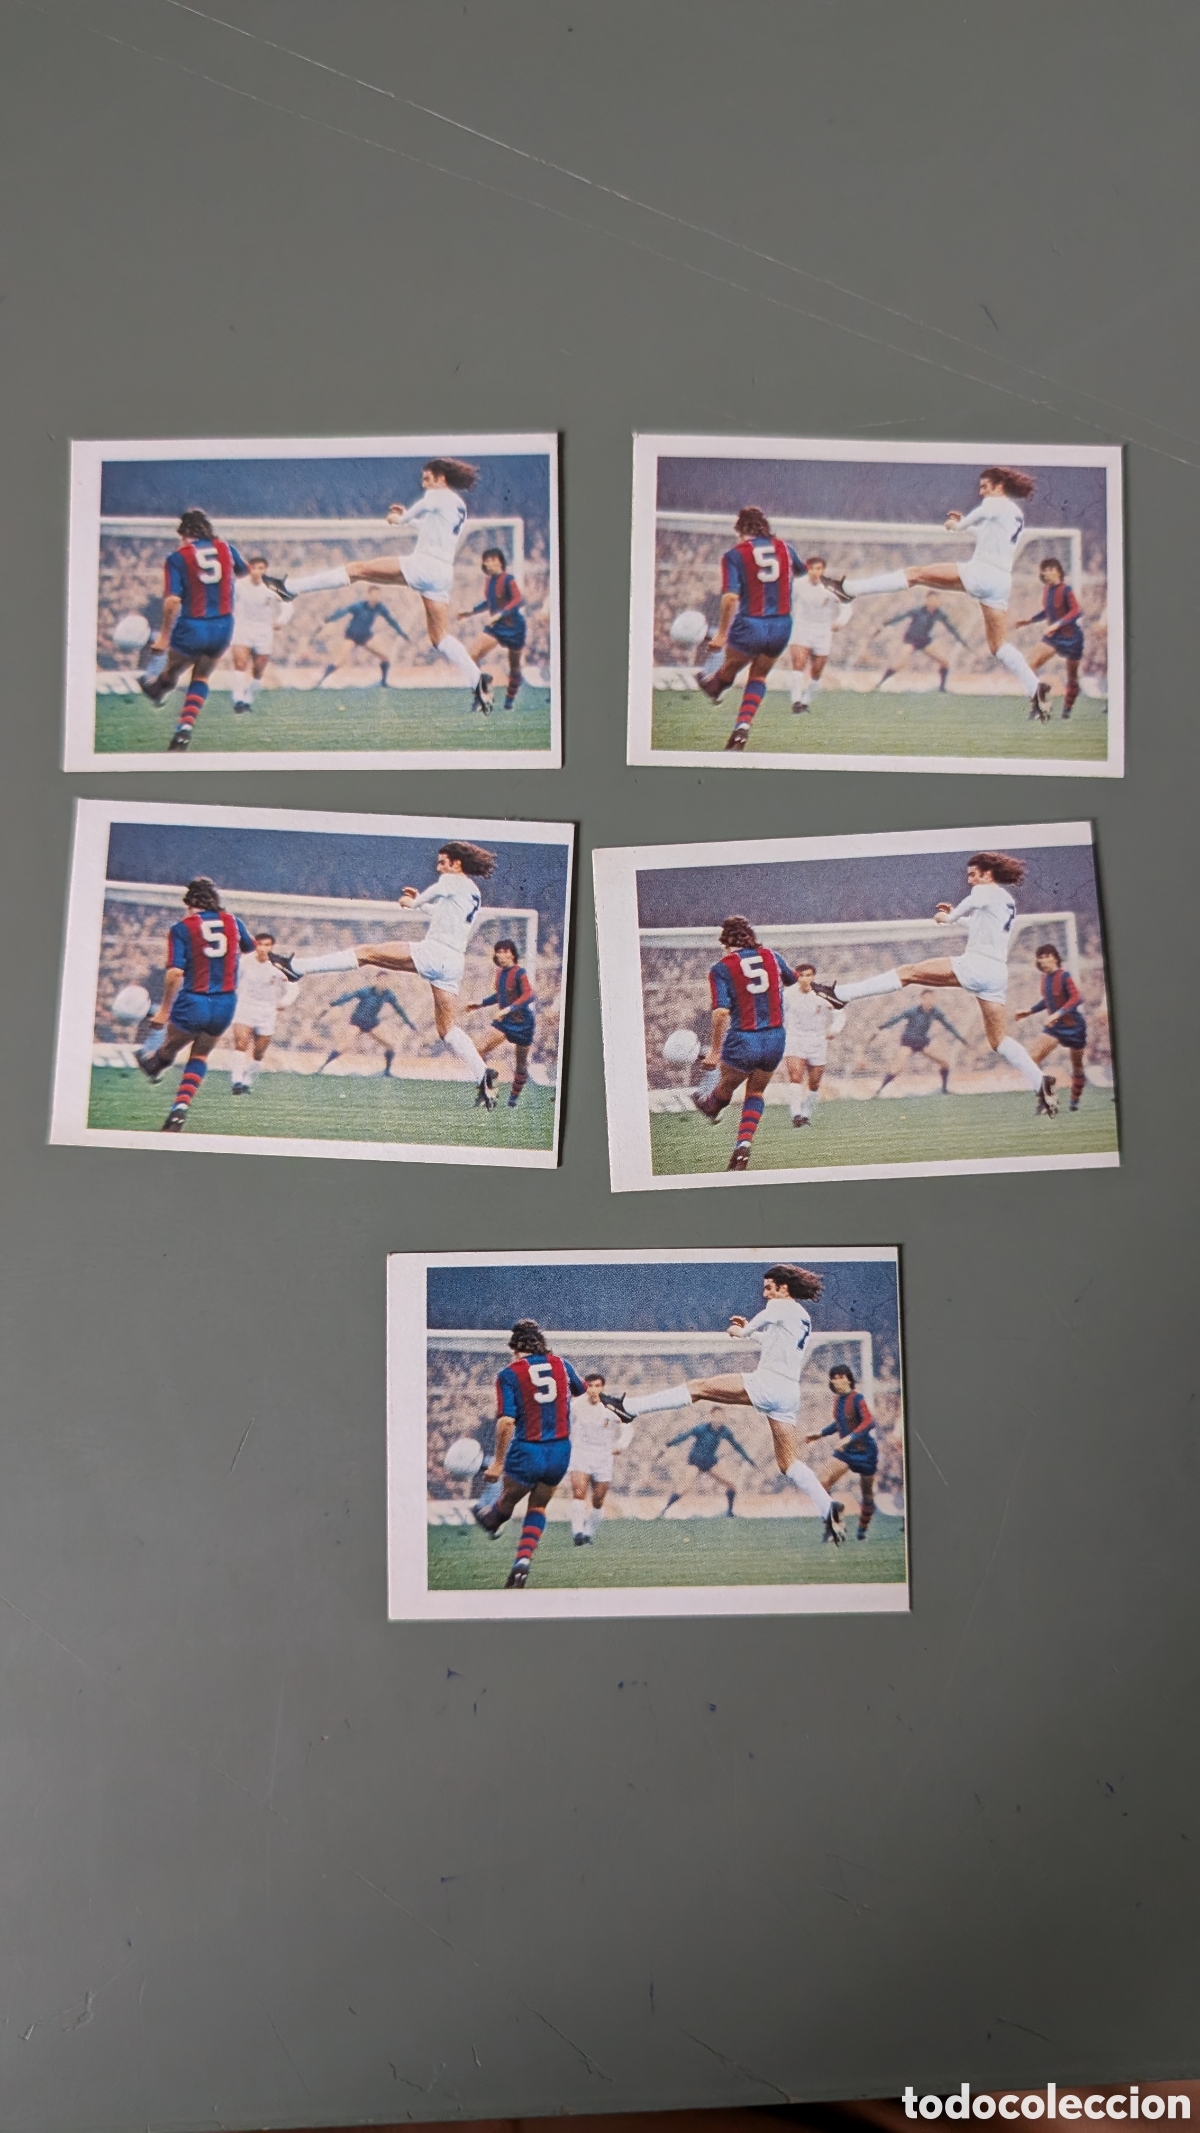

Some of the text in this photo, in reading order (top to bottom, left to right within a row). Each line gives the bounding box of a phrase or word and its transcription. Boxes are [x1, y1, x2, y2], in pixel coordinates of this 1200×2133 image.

[195, 548, 222, 584] 5
[752, 546, 780, 582] 5
[201, 920, 229, 958] 5
[740, 956, 769, 994] 5
[528, 1363, 557, 1403] 5
